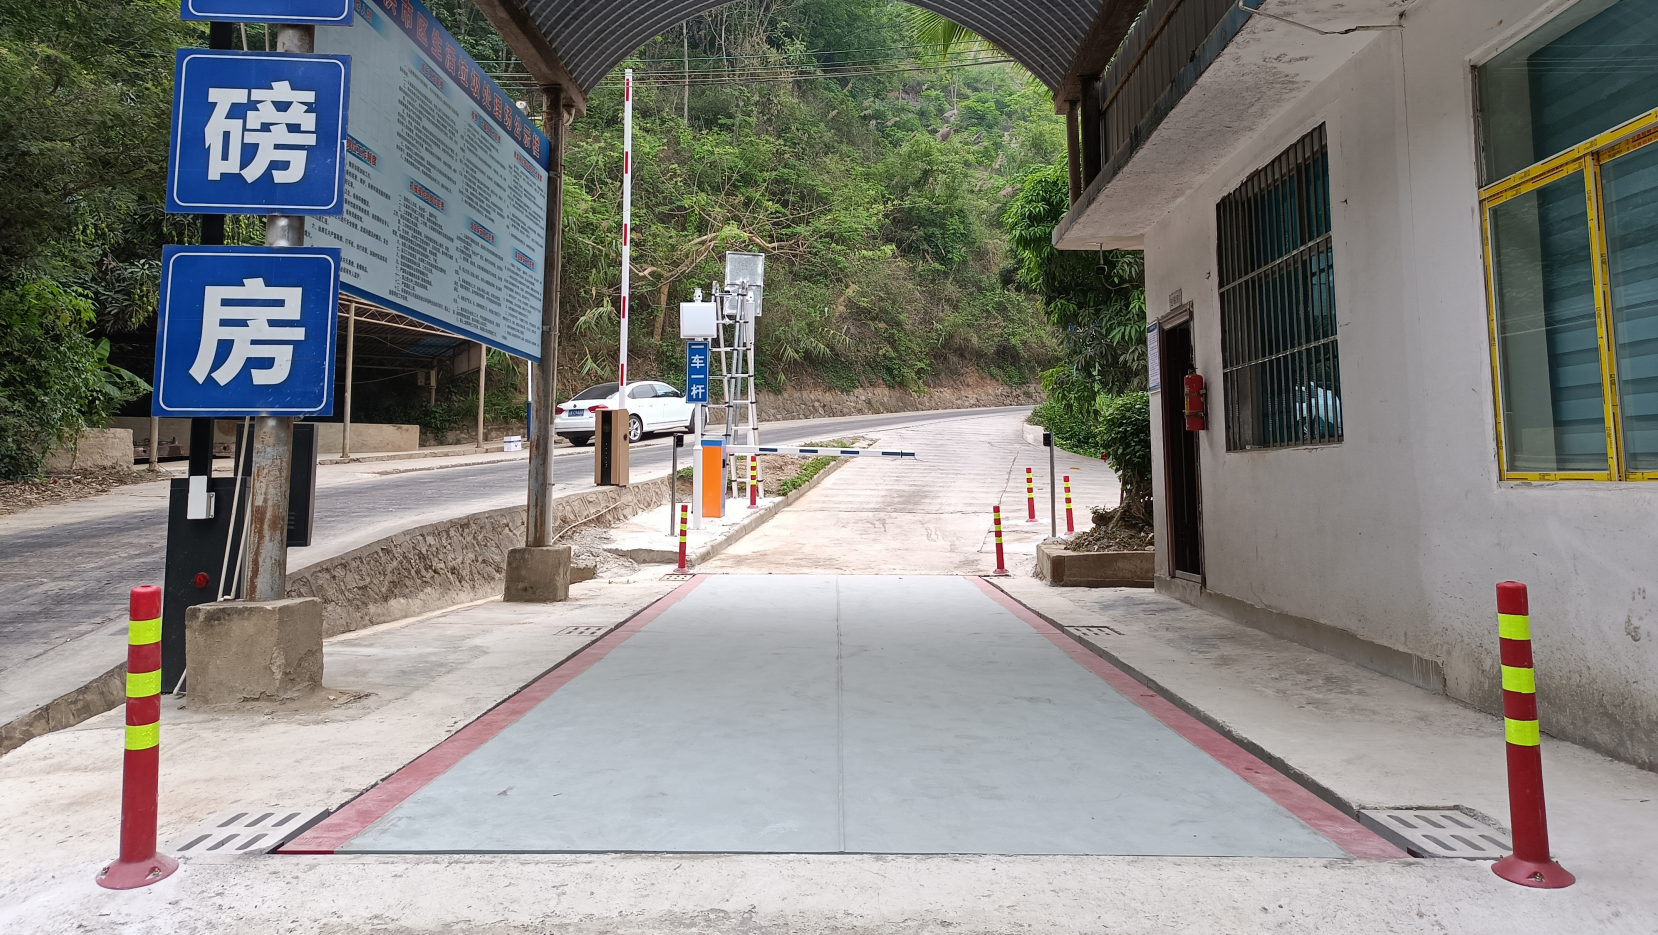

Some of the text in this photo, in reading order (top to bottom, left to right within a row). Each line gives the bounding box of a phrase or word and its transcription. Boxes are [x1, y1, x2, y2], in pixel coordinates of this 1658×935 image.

[203, 80, 317, 184] 磅
[188, 277, 306, 386] 房
[690, 345, 706, 399] 一车一杆
